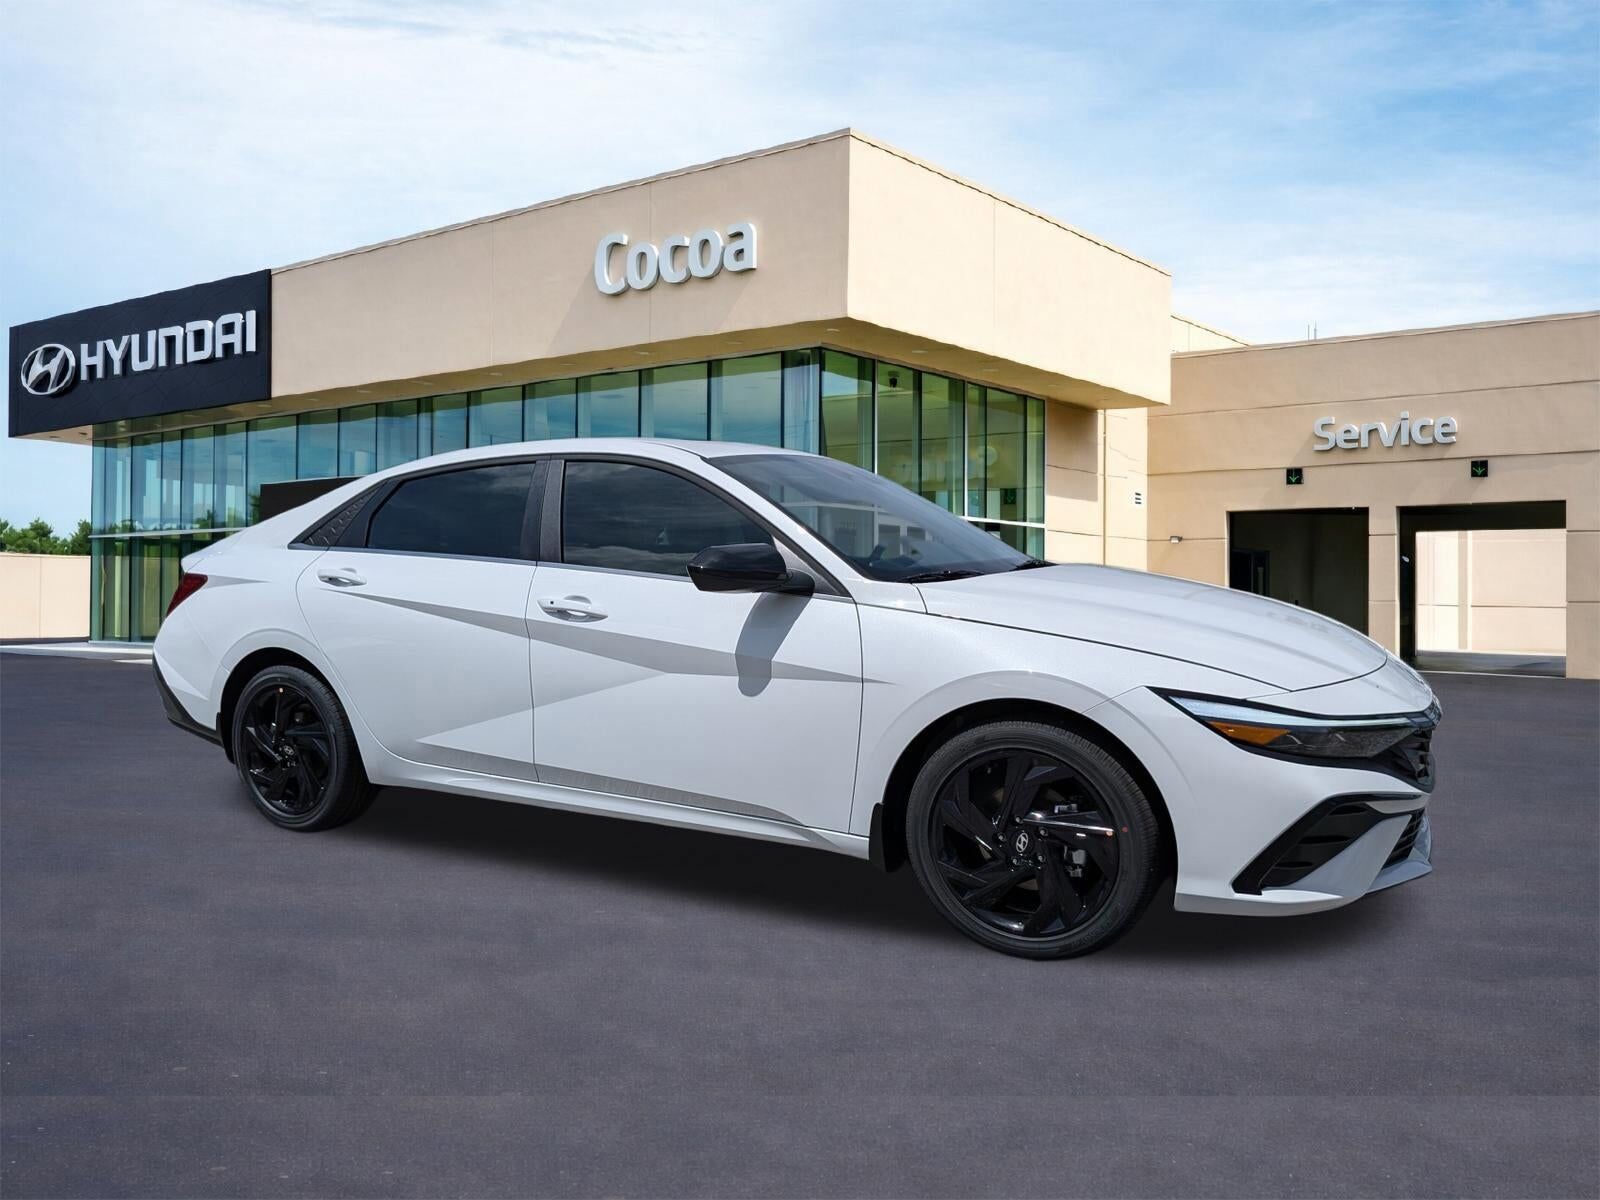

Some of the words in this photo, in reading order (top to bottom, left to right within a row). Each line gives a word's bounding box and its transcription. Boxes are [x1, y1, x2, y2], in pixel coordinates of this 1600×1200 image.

[594, 222, 758, 295] Cocoa
[80, 310, 257, 381] HYUNDAI
[1313, 410, 1458, 451] Service
